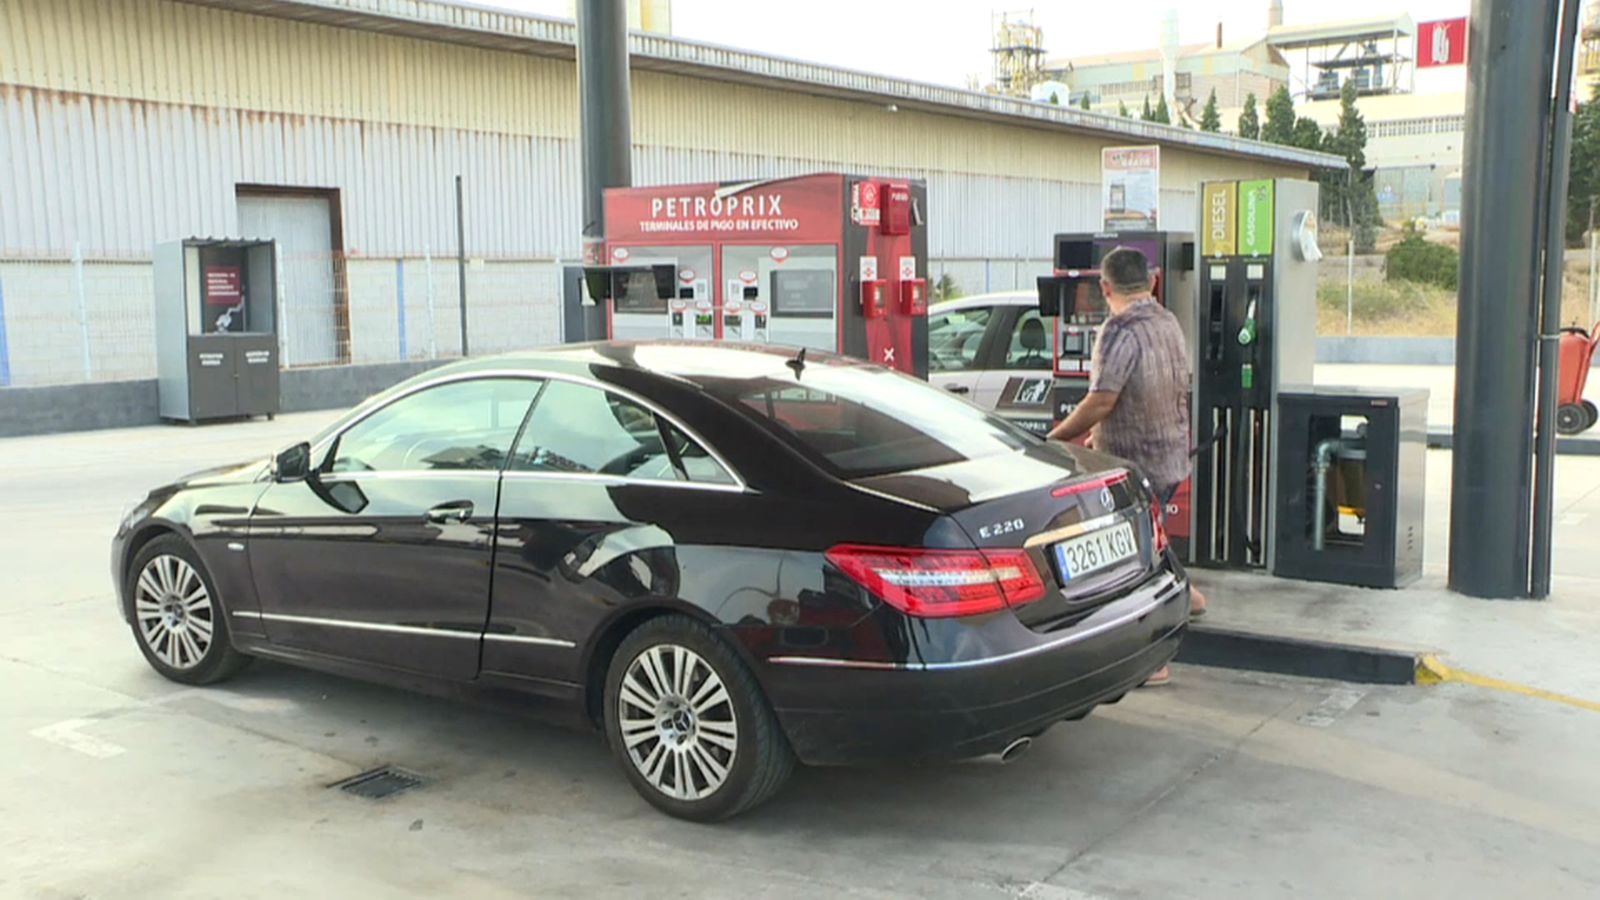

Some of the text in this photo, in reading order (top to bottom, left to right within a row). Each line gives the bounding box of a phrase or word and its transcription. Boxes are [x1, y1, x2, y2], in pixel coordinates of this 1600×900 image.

[652, 195, 782, 218] PETROPRIX
[1212, 189, 1226, 240] DIESEL
[1247, 190, 1256, 246] GASOLINA
[640, 218, 798, 232] TERMINALES DE PAGO EN EFECTIVO
[979, 518, 1024, 539] E 220
[1067, 526, 1135, 573] 3261 KGV
